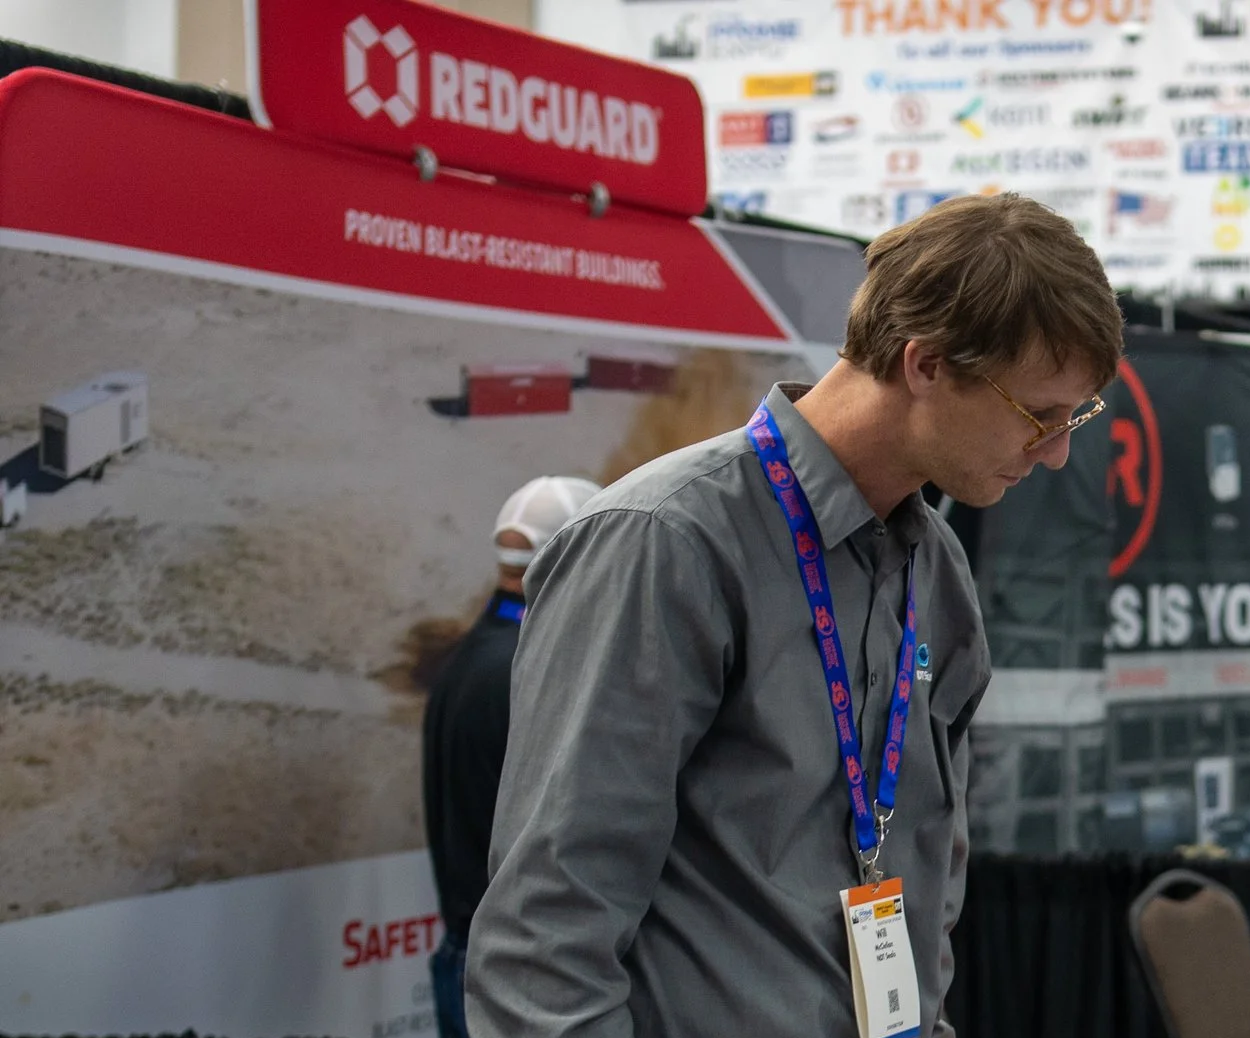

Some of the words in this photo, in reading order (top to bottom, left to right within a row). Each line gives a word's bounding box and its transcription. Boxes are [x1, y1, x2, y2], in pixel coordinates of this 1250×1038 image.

[837, 0, 1010, 37] THANK
[345, 208, 422, 253] PROVEN
[424, 225, 575, 277] BLAST-RESISTANT
[1103, 583, 1142, 648] S
[1147, 584, 1193, 646] IS
[342, 911, 441, 970] SAFET
